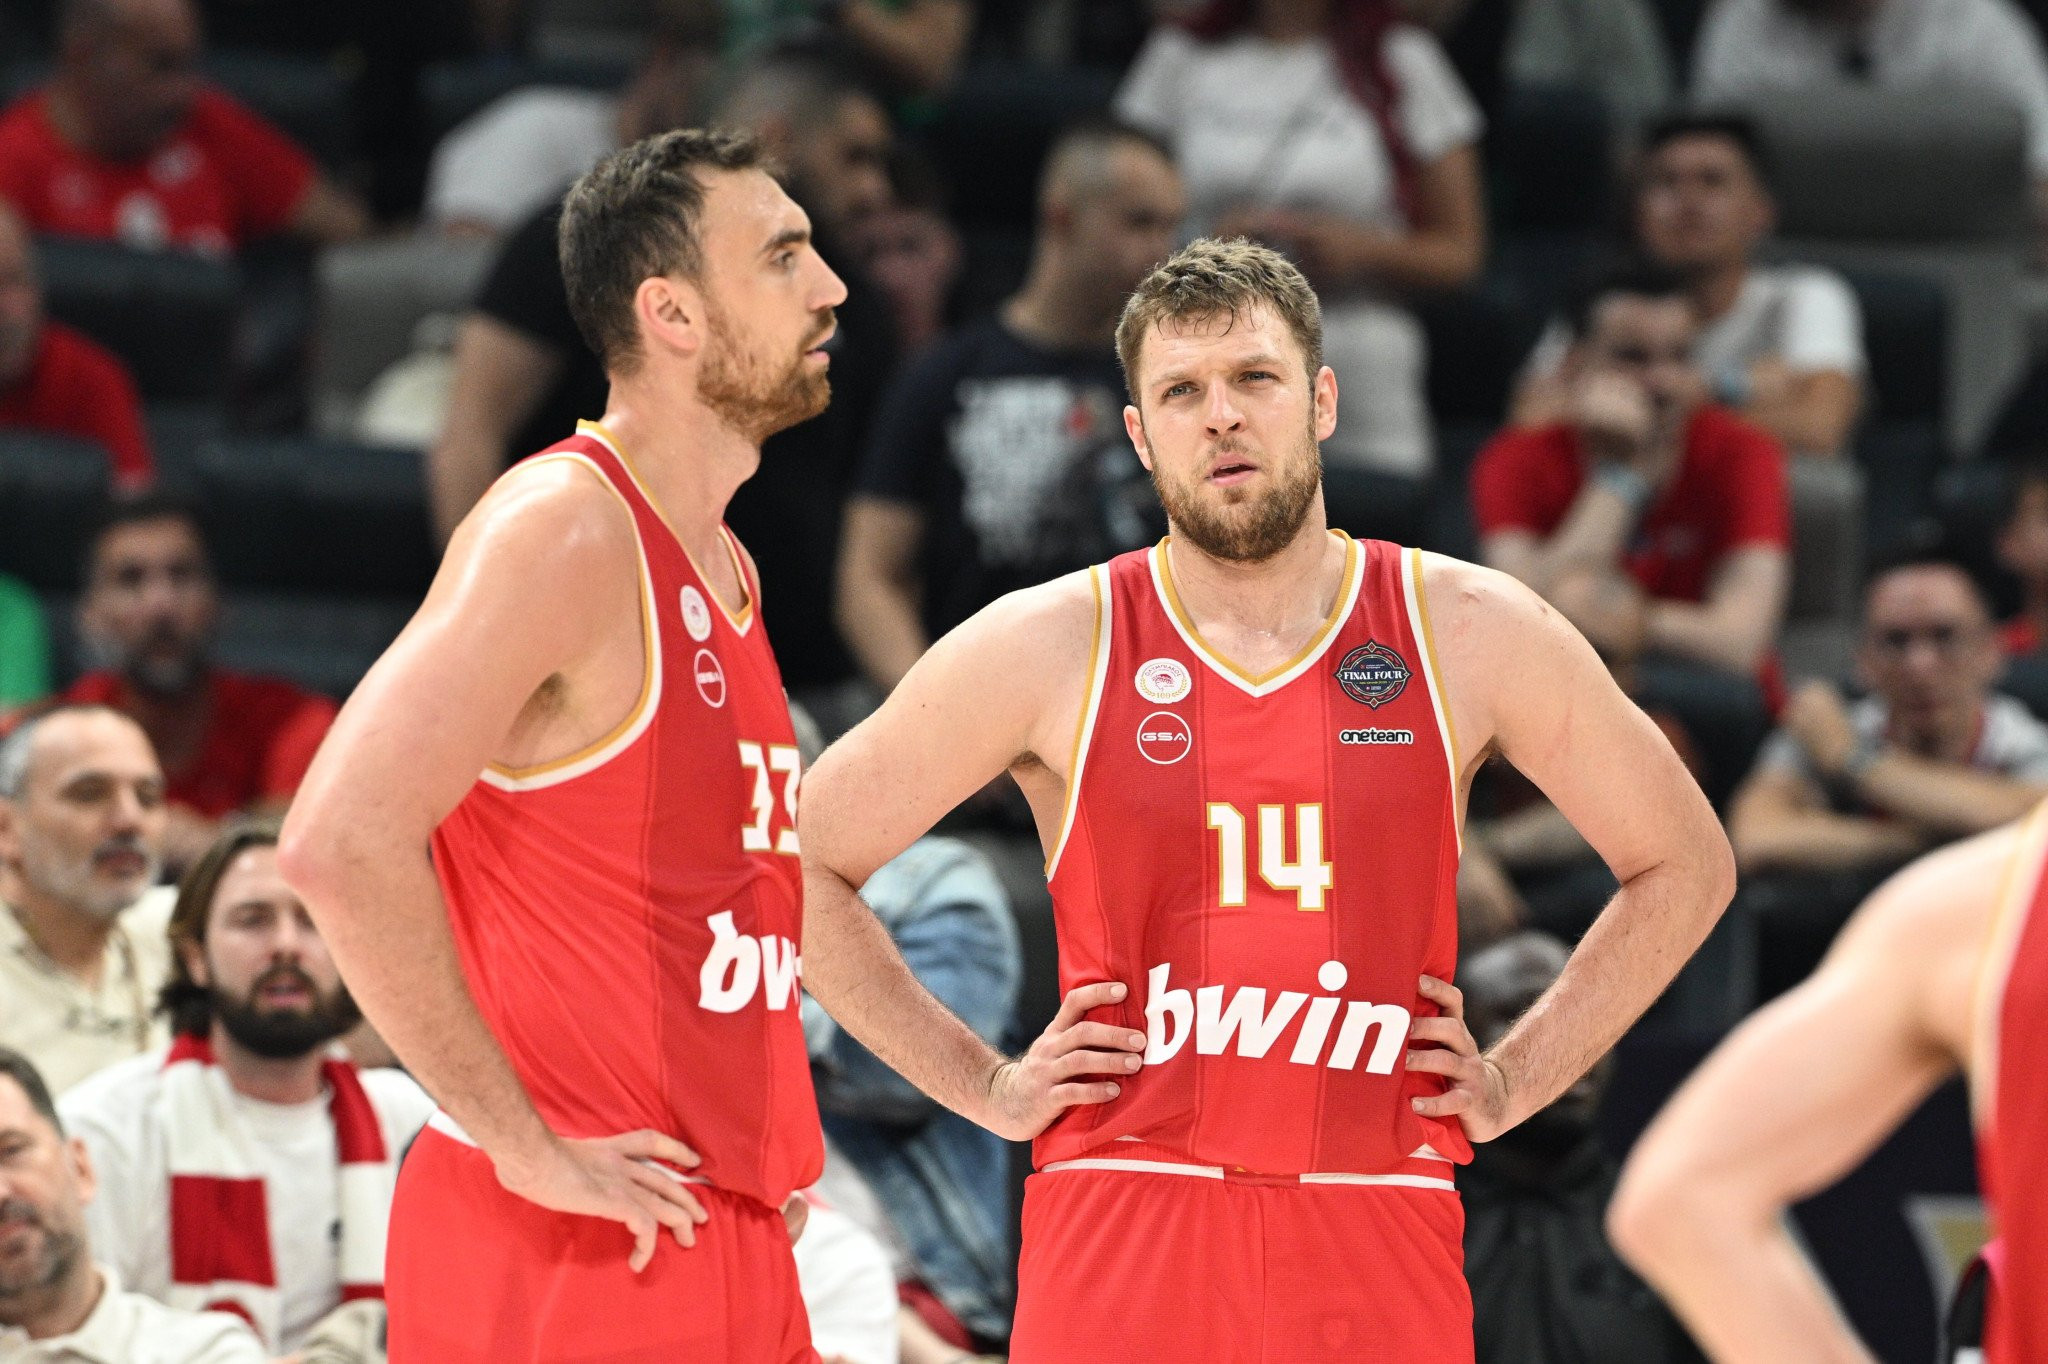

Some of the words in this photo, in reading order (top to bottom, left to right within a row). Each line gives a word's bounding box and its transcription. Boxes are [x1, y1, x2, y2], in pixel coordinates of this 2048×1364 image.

[1343, 671, 1373, 680] FINAL
[1374, 670, 1403, 680] FOUR
[1141, 732, 1187, 742] GSA
[1340, 728, 1413, 743] oneteam
[737, 739, 801, 856] 33
[1206, 802, 1333, 911] 14
[698, 910, 803, 1020] bw
[1143, 962, 1411, 1075] bwin
